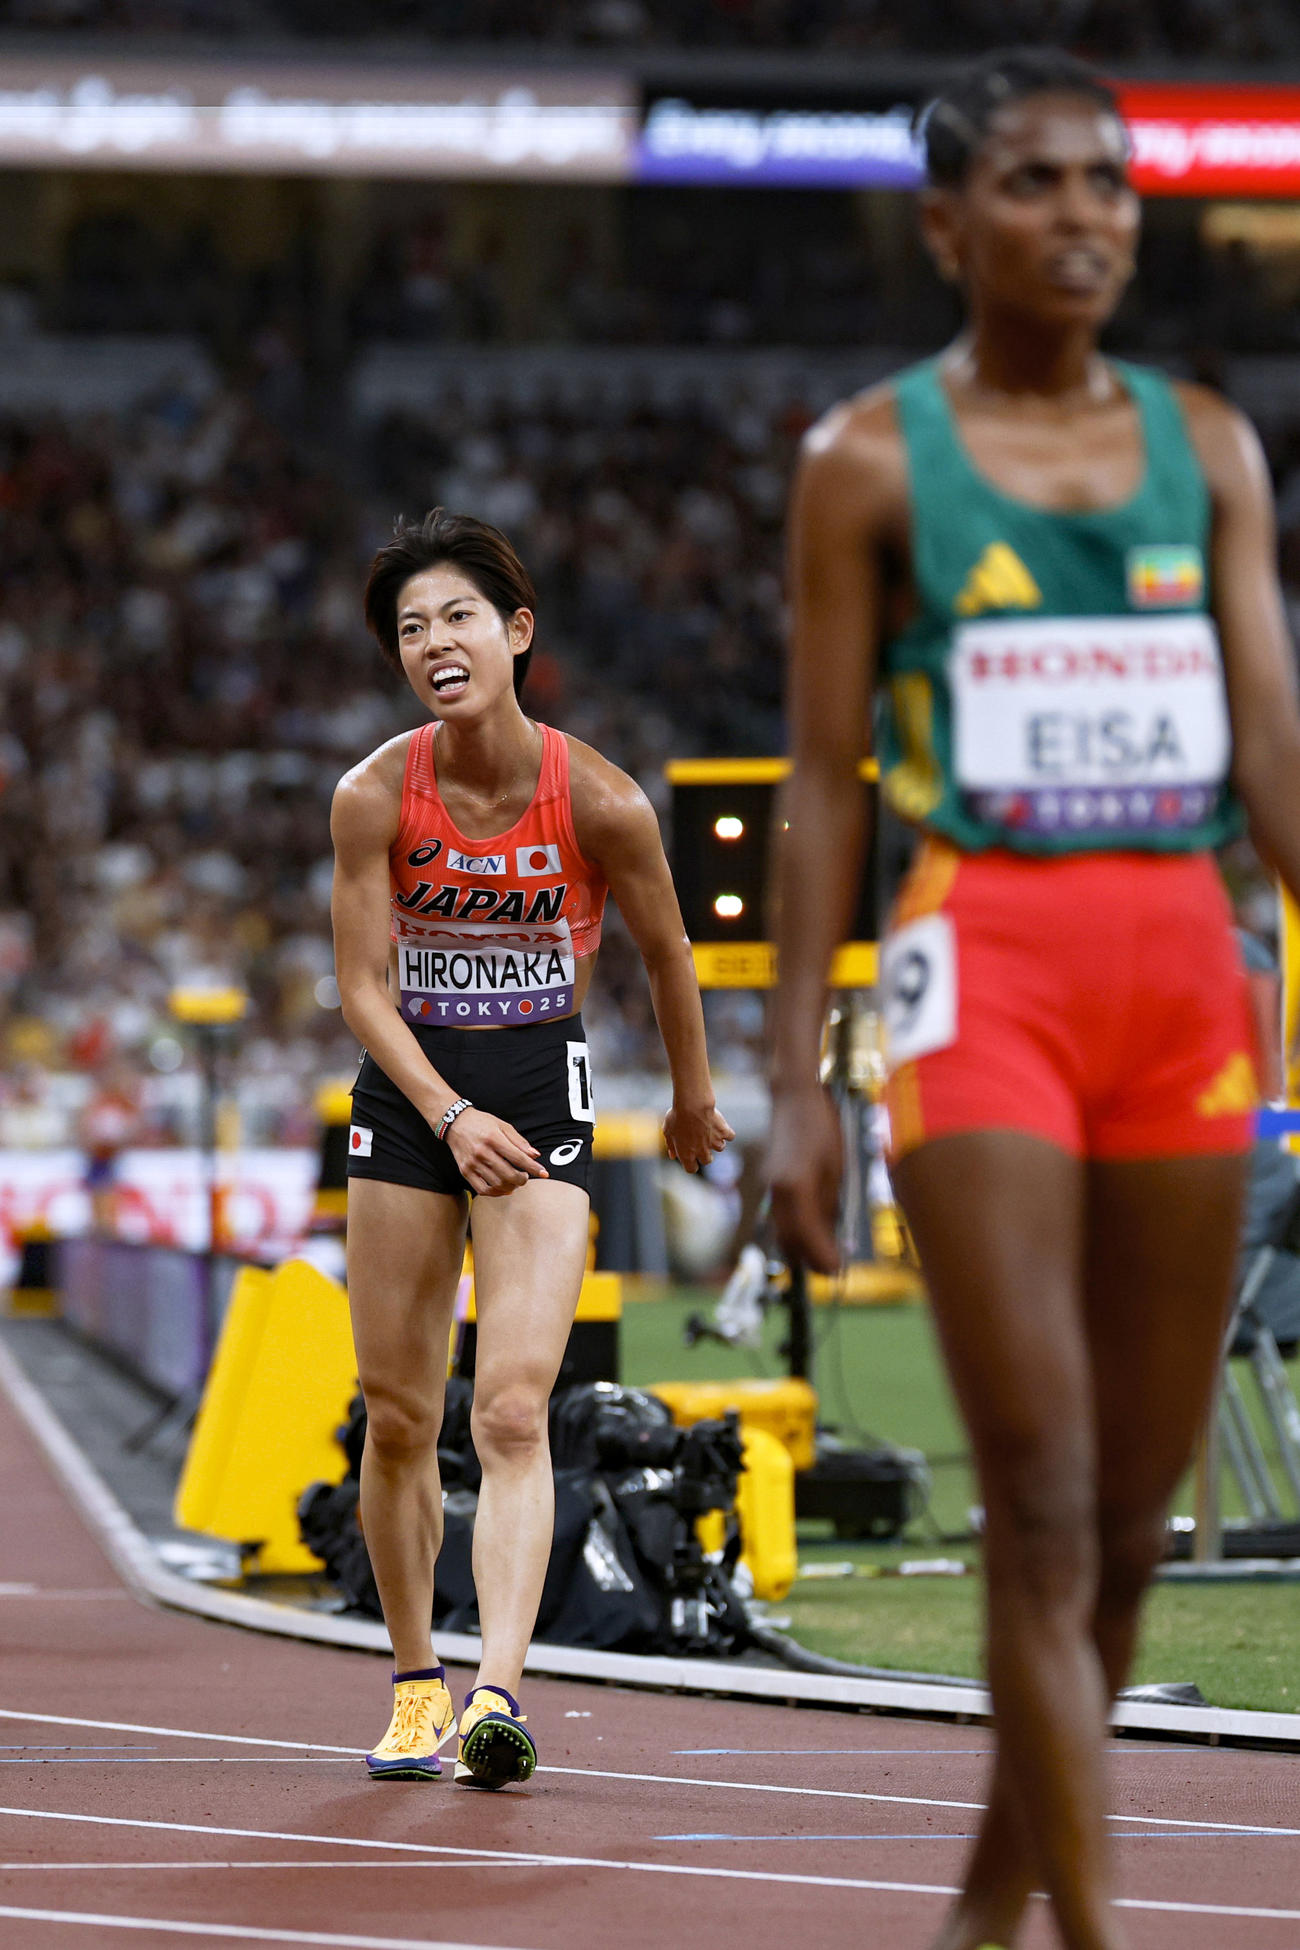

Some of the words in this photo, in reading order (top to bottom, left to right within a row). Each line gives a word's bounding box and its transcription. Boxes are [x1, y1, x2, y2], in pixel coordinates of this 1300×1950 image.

[1026, 709, 1188, 773] EISA
[449, 854, 504, 873] ACN
[396, 881, 567, 923] JAPAN
[406, 949, 567, 989] HIRONAKA
[539, 994, 566, 1011] 25
[572, 1055, 593, 1110] 1
